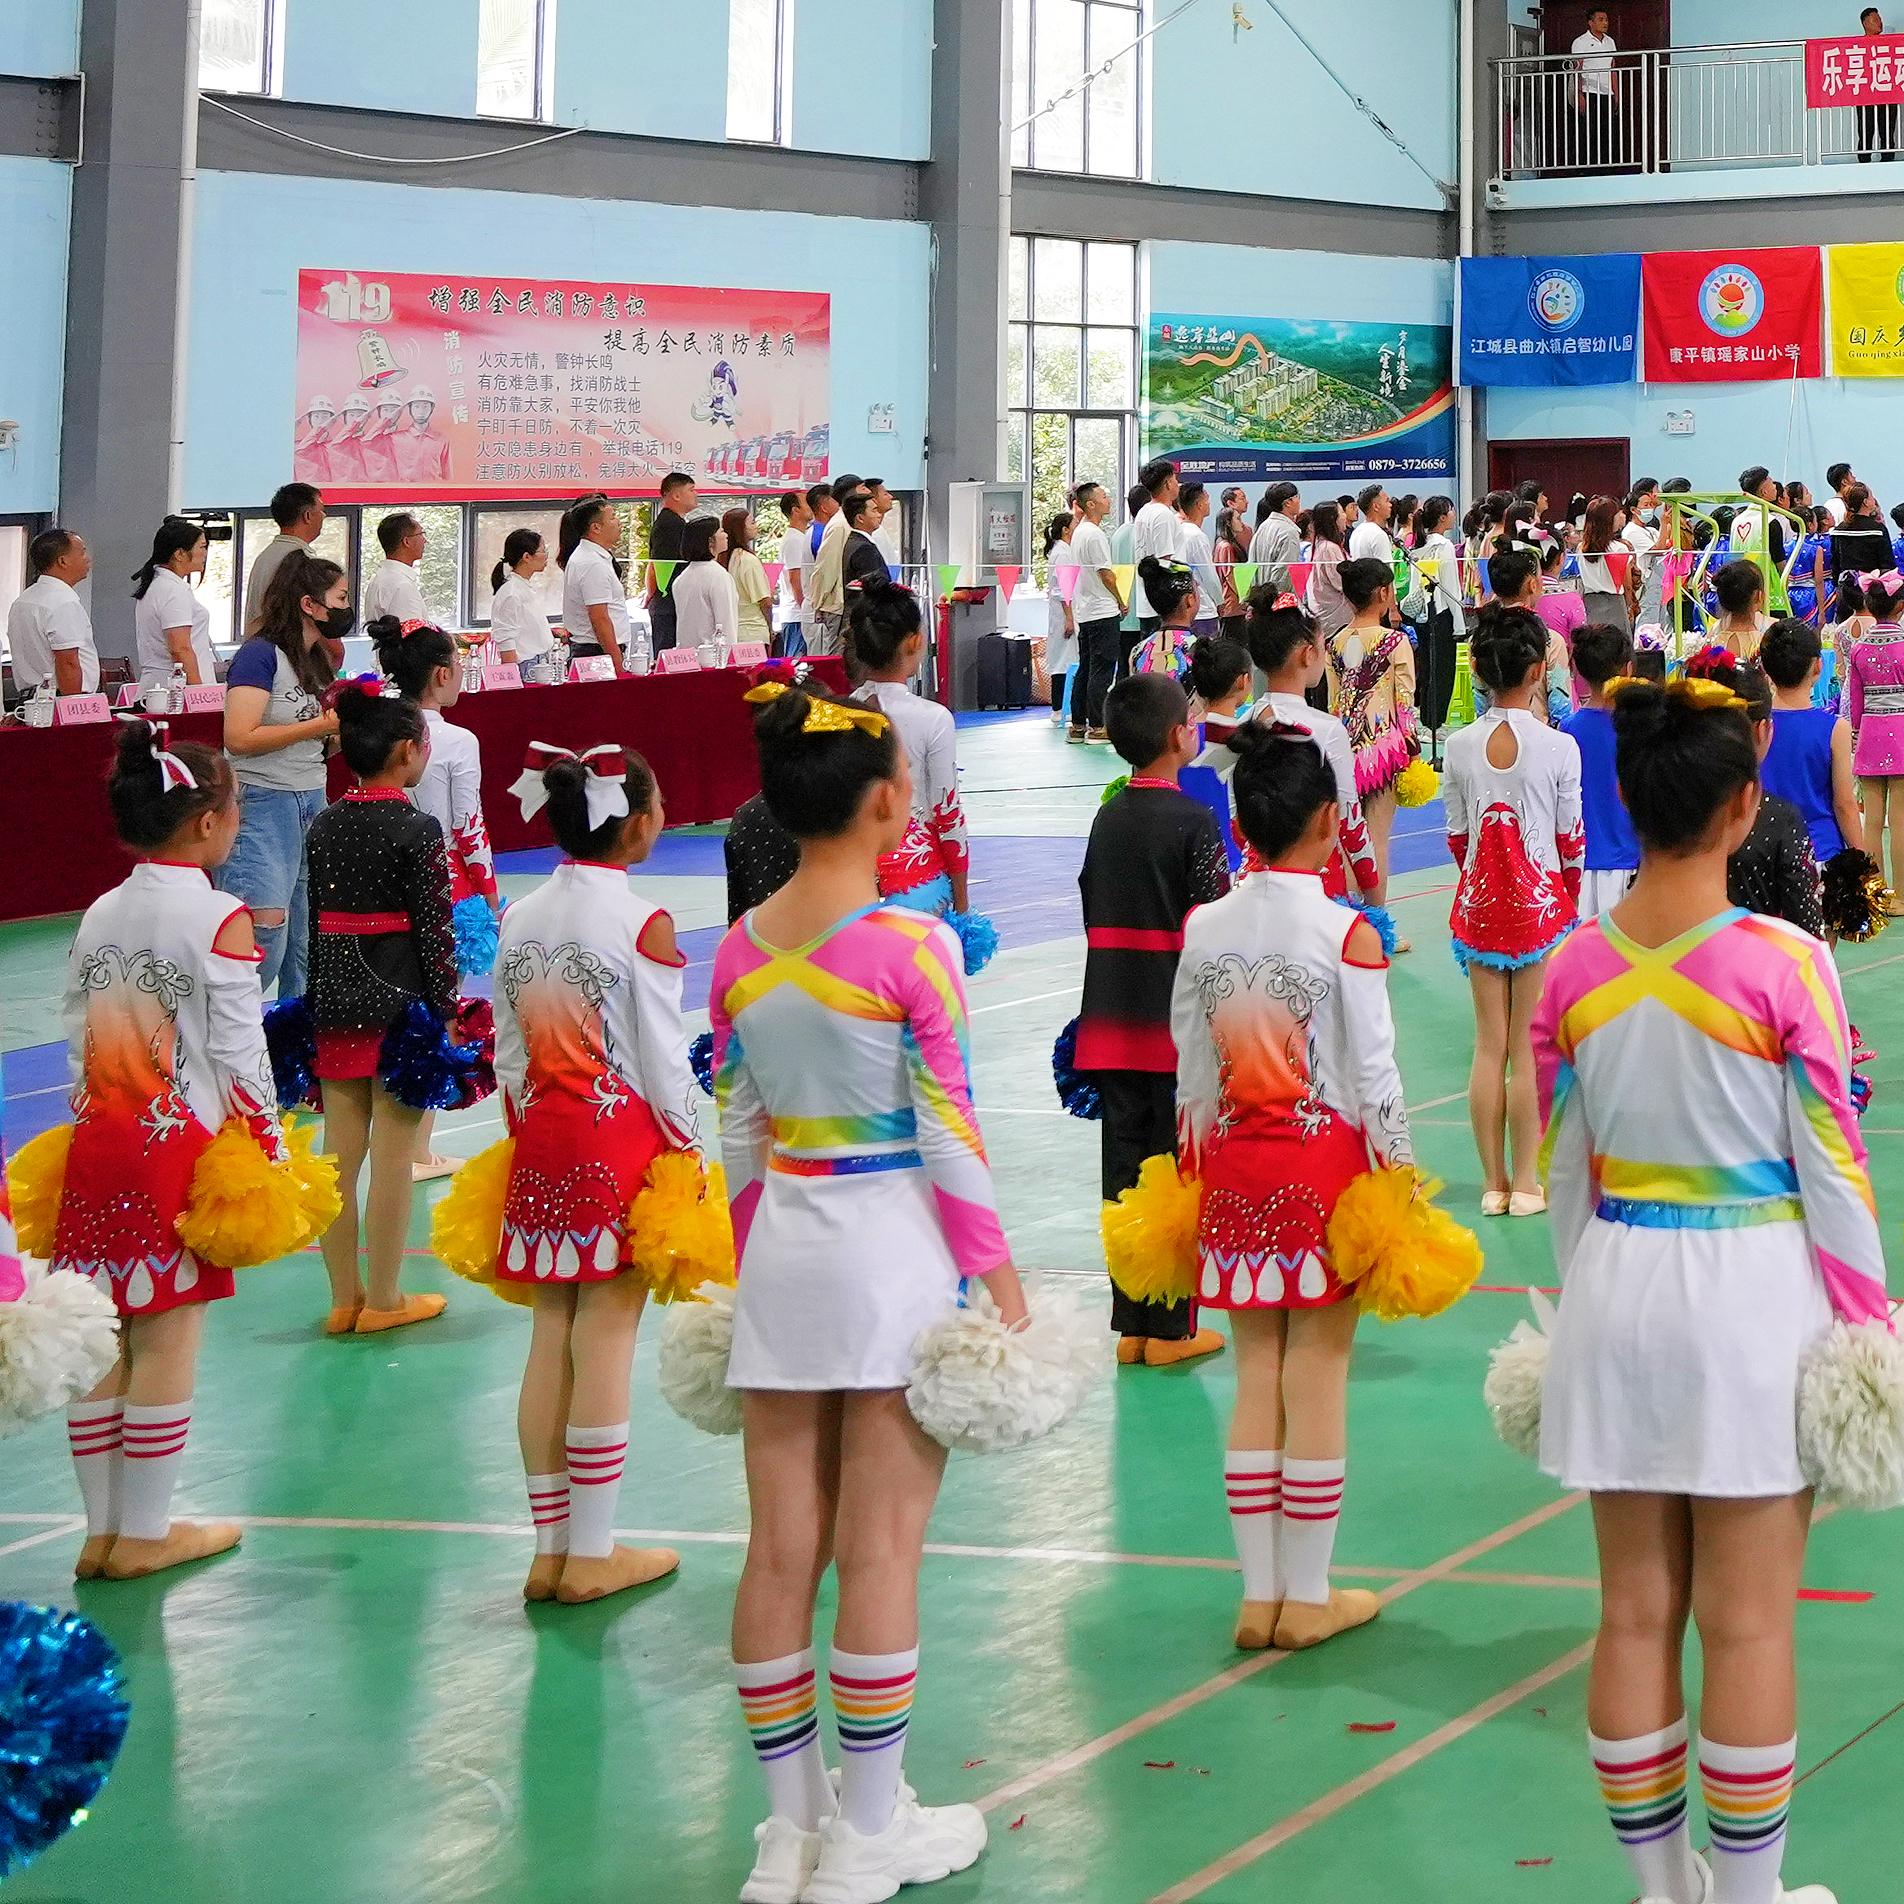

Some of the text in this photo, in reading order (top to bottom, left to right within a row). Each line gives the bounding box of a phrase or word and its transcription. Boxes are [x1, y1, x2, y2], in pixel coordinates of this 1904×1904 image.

[320, 273, 392, 324] 119
[427, 286, 647, 318] 增强全民消防意识
[603, 328, 797, 357] 提高全民消防素质
[1470, 334, 1634, 355] 江城县曲水镇启智幼儿园
[478, 351, 613, 371] 火灾无情，警钟长鸣
[1669, 343, 1801, 365] 康平镇瑶家山小学
[442, 330, 470, 425] 消防宣传
[477, 374, 641, 392] 有危难急事，找消防战士
[477, 396, 641, 414] 消防靠大家，平安你我他
